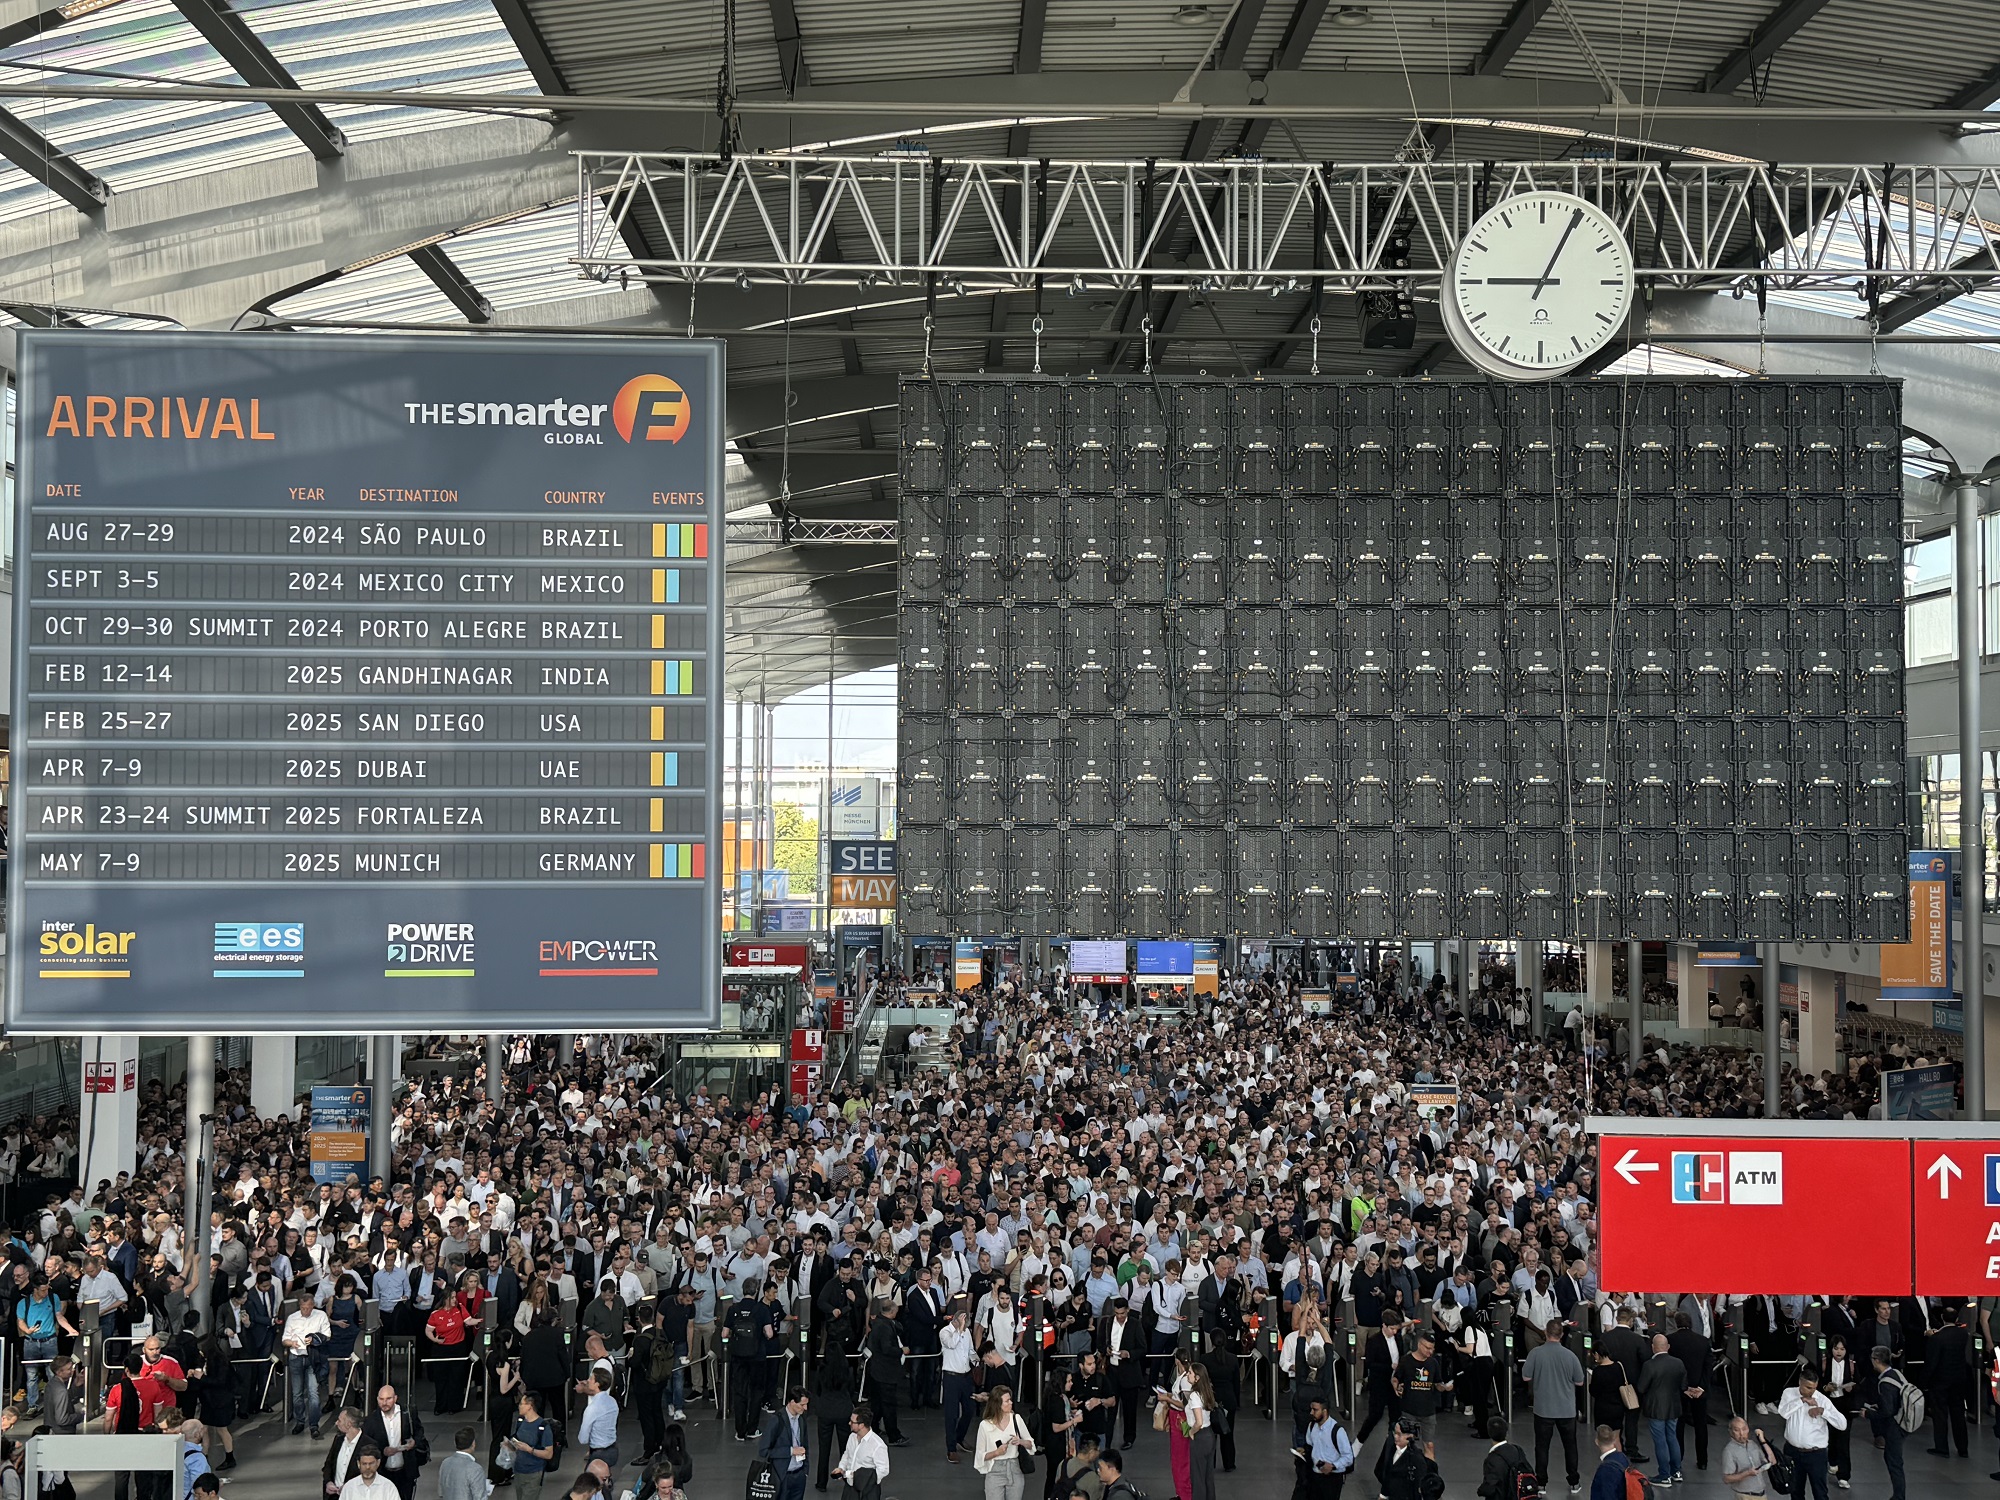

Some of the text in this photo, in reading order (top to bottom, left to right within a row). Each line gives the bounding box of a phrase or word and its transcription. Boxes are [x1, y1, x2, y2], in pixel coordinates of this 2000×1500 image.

[47, 395, 276, 441] ARRIVAL
[543, 432, 604, 445] GLOBAL
[46, 483, 705, 505] DATE YEAR DESTINATION COUNTRY EVENTS
[46, 522, 88, 541] AUG
[289, 525, 345, 544] 2024
[360, 522, 401, 545] SÃO
[417, 527, 486, 546] PAULO
[543, 529, 624, 547] BRAZIL
[47, 569, 103, 588] SEPT
[288, 572, 344, 591] 2024
[359, 573, 444, 592] MEXICO
[459, 574, 514, 593] CITY
[541, 575, 624, 594] MEXICO
[45, 616, 88, 635] OCT
[189, 617, 274, 637] SUMMIT
[288, 618, 344, 637] 2024
[359, 619, 429, 638] PORTO
[443, 620, 527, 639] ALEGRE
[542, 621, 623, 639] BRAZIL
[46, 664, 85, 682] FEB
[287, 665, 342, 684] 2025
[358, 666, 513, 685] GANDHINAGAR
[541, 667, 610, 686] INDIA
[44, 711, 85, 730] FEB
[286, 712, 342, 732] 2025
[358, 713, 399, 732] SAN
[415, 713, 484, 732] DIEGO
[540, 713, 581, 732] USA
[42, 758, 85, 777] APR
[286, 759, 341, 778] 2025
[358, 760, 427, 779] DUBAI
[540, 760, 580, 779] UAE
[41, 805, 84, 824] APR
[186, 806, 271, 825] SUMMIT
[285, 806, 341, 825] 2025
[358, 806, 484, 825] FORTALEZA
[540, 807, 621, 825] BRAZIL
[40, 853, 83, 872] MAY
[284, 853, 340, 872] 2025
[355, 853, 440, 872] MUNICH
[539, 853, 636, 872] GERMANY
[841, 846, 893, 871] SEE
[841, 879, 897, 902] MAY
[42, 920, 76, 932] inter
[387, 923, 475, 942] POWER
[1929, 885, 1942, 983] SAVE THE DATE
[40, 924, 137, 956] solar
[539, 940, 659, 962] EMPOWER
[213, 953, 304, 963] electrical energy storage
[410, 943, 475, 963] DRIVE
[1734, 1171, 1777, 1185] ATM
